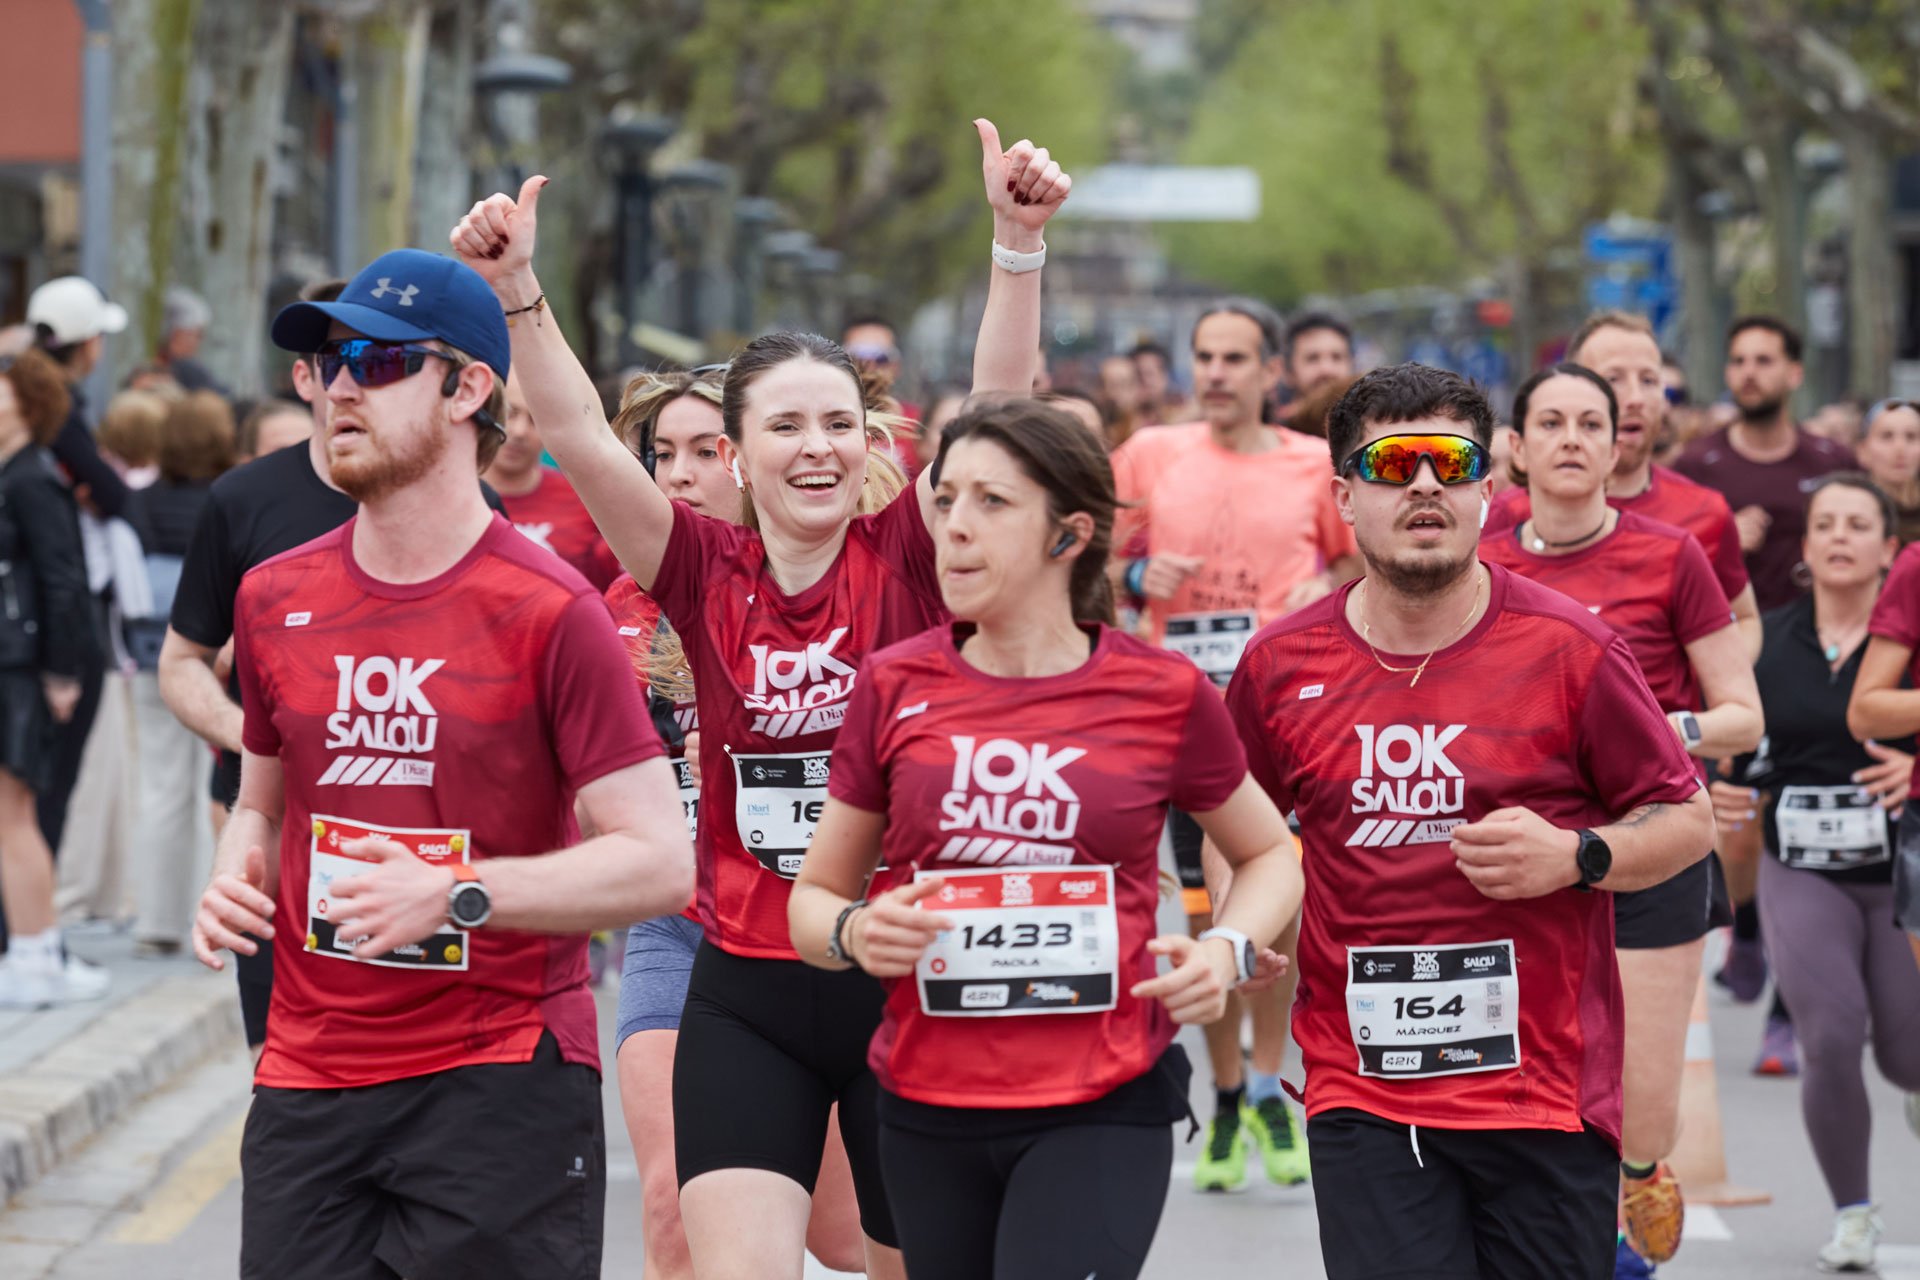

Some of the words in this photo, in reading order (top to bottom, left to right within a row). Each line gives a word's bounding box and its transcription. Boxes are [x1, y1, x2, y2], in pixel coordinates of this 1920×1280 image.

[748, 626, 856, 695] 10K
[334, 655, 447, 716] 10K
[743, 678, 856, 712] SALOU
[820, 708, 846, 722] Dia
[325, 711, 439, 753] SALOU
[1354, 724, 1468, 778] 10K
[950, 735, 1088, 803] 10K
[1351, 778, 1465, 816] SALOU
[791, 801, 826, 823] 16
[939, 790, 1081, 840] SALOU
[781, 859, 802, 869] 42
[963, 923, 1073, 950] 1433
[991, 958, 1040, 968] PAOLA
[1413, 952, 1438, 966] 10K
[1463, 955, 1496, 969] SALOU
[1393, 994, 1466, 1020] 164
[1396, 1025, 1462, 1036] MÁRQUEZ
[1385, 1056, 1417, 1066] 42K
